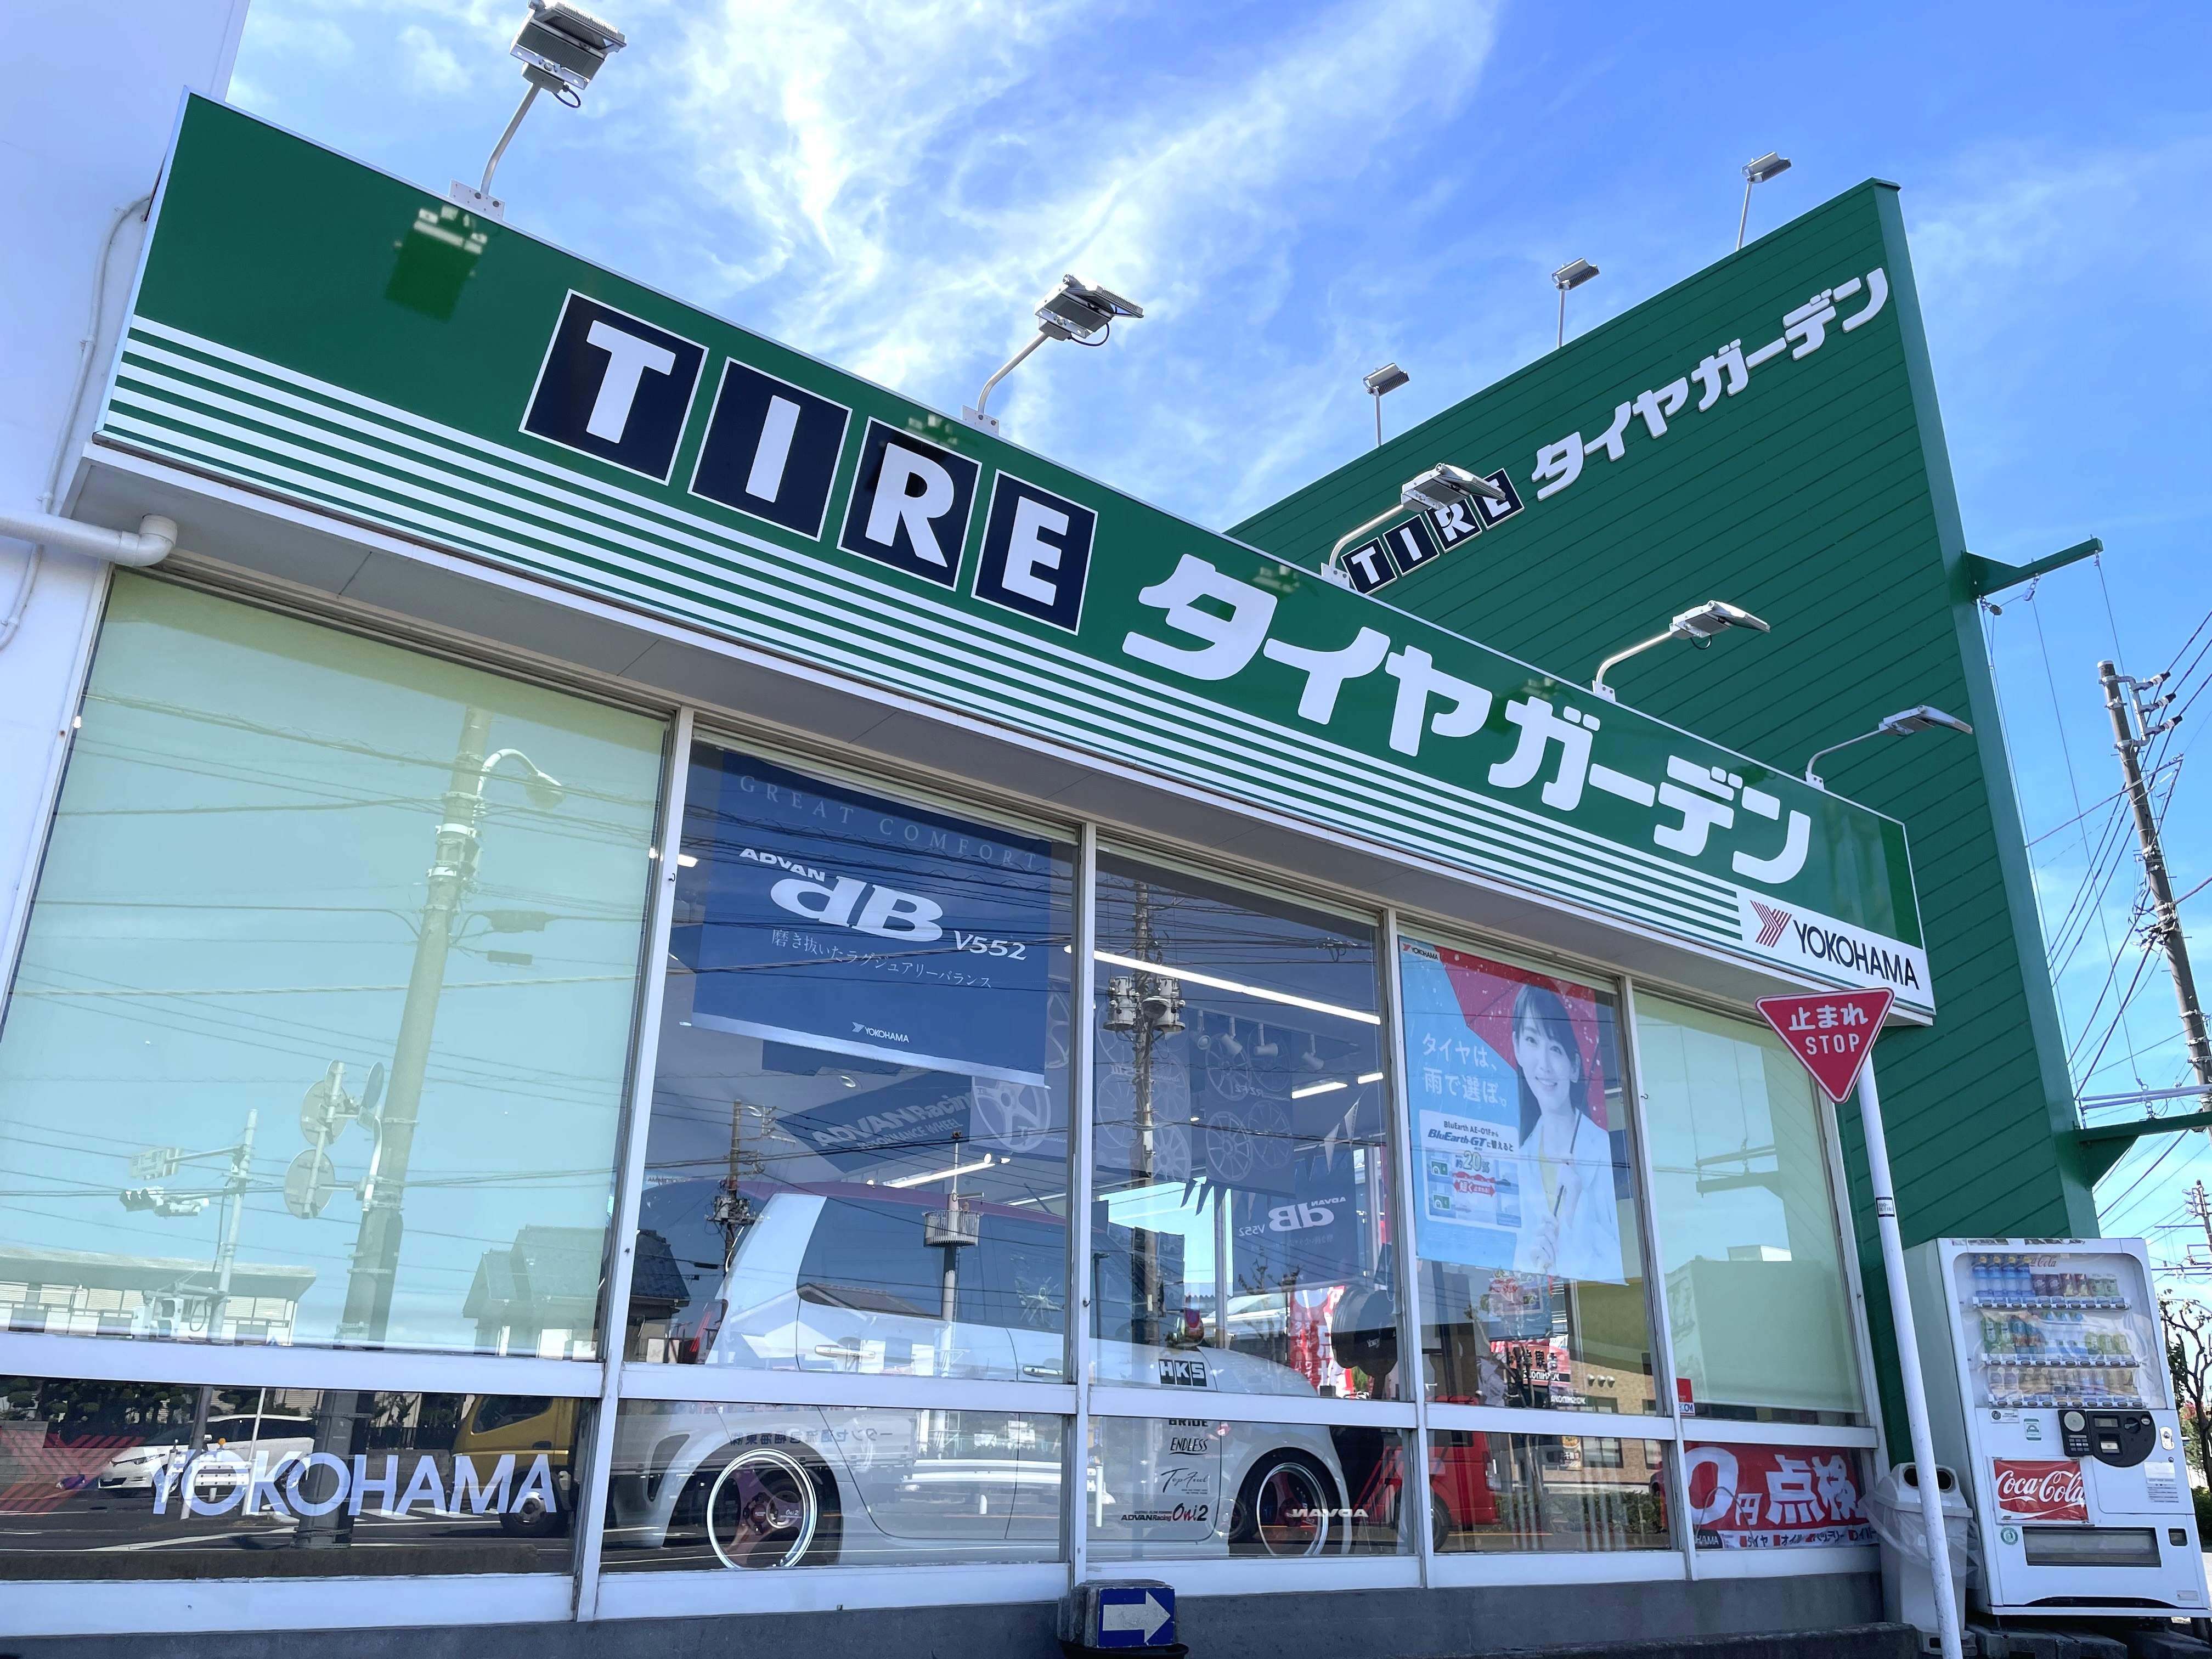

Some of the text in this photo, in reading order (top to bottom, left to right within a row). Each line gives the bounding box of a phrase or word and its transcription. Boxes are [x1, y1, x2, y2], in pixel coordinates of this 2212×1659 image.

[1531, 267, 1889, 501] タイヤガーデン
[586, 320, 1069, 606] TIRE
[1352, 478, 1512, 583] TIRE
[1122, 553, 1811, 884] タイヤガーデン
[740, 775, 1037, 868] GREAT COMFORT
[738, 848, 826, 882] ADVAN
[770, 875, 1028, 961] dB V552
[771, 929, 992, 988] 磨き抜いたラグジュアリーバランス
[1411, 946, 1438, 961] YOKOHAMA
[1793, 919, 1920, 990] YOKOHAMA
[865, 1026, 910, 1043] YOKOHAMA
[1788, 1002, 1869, 1031] 止まれ
[1422, 1033, 1497, 1071] タイヤは、
[1805, 1033, 1860, 1055] STOP
[926, 1118, 964, 1135] WHEEL
[1444, 1121, 1469, 1132] BluEarth
[1159, 1360, 1206, 1384] HKS
[1170, 1437, 1209, 1454] ENDLESS
[146, 1448, 556, 1517] YOKOHAMA
[1996, 1470, 2085, 1502] Coca-Cola
